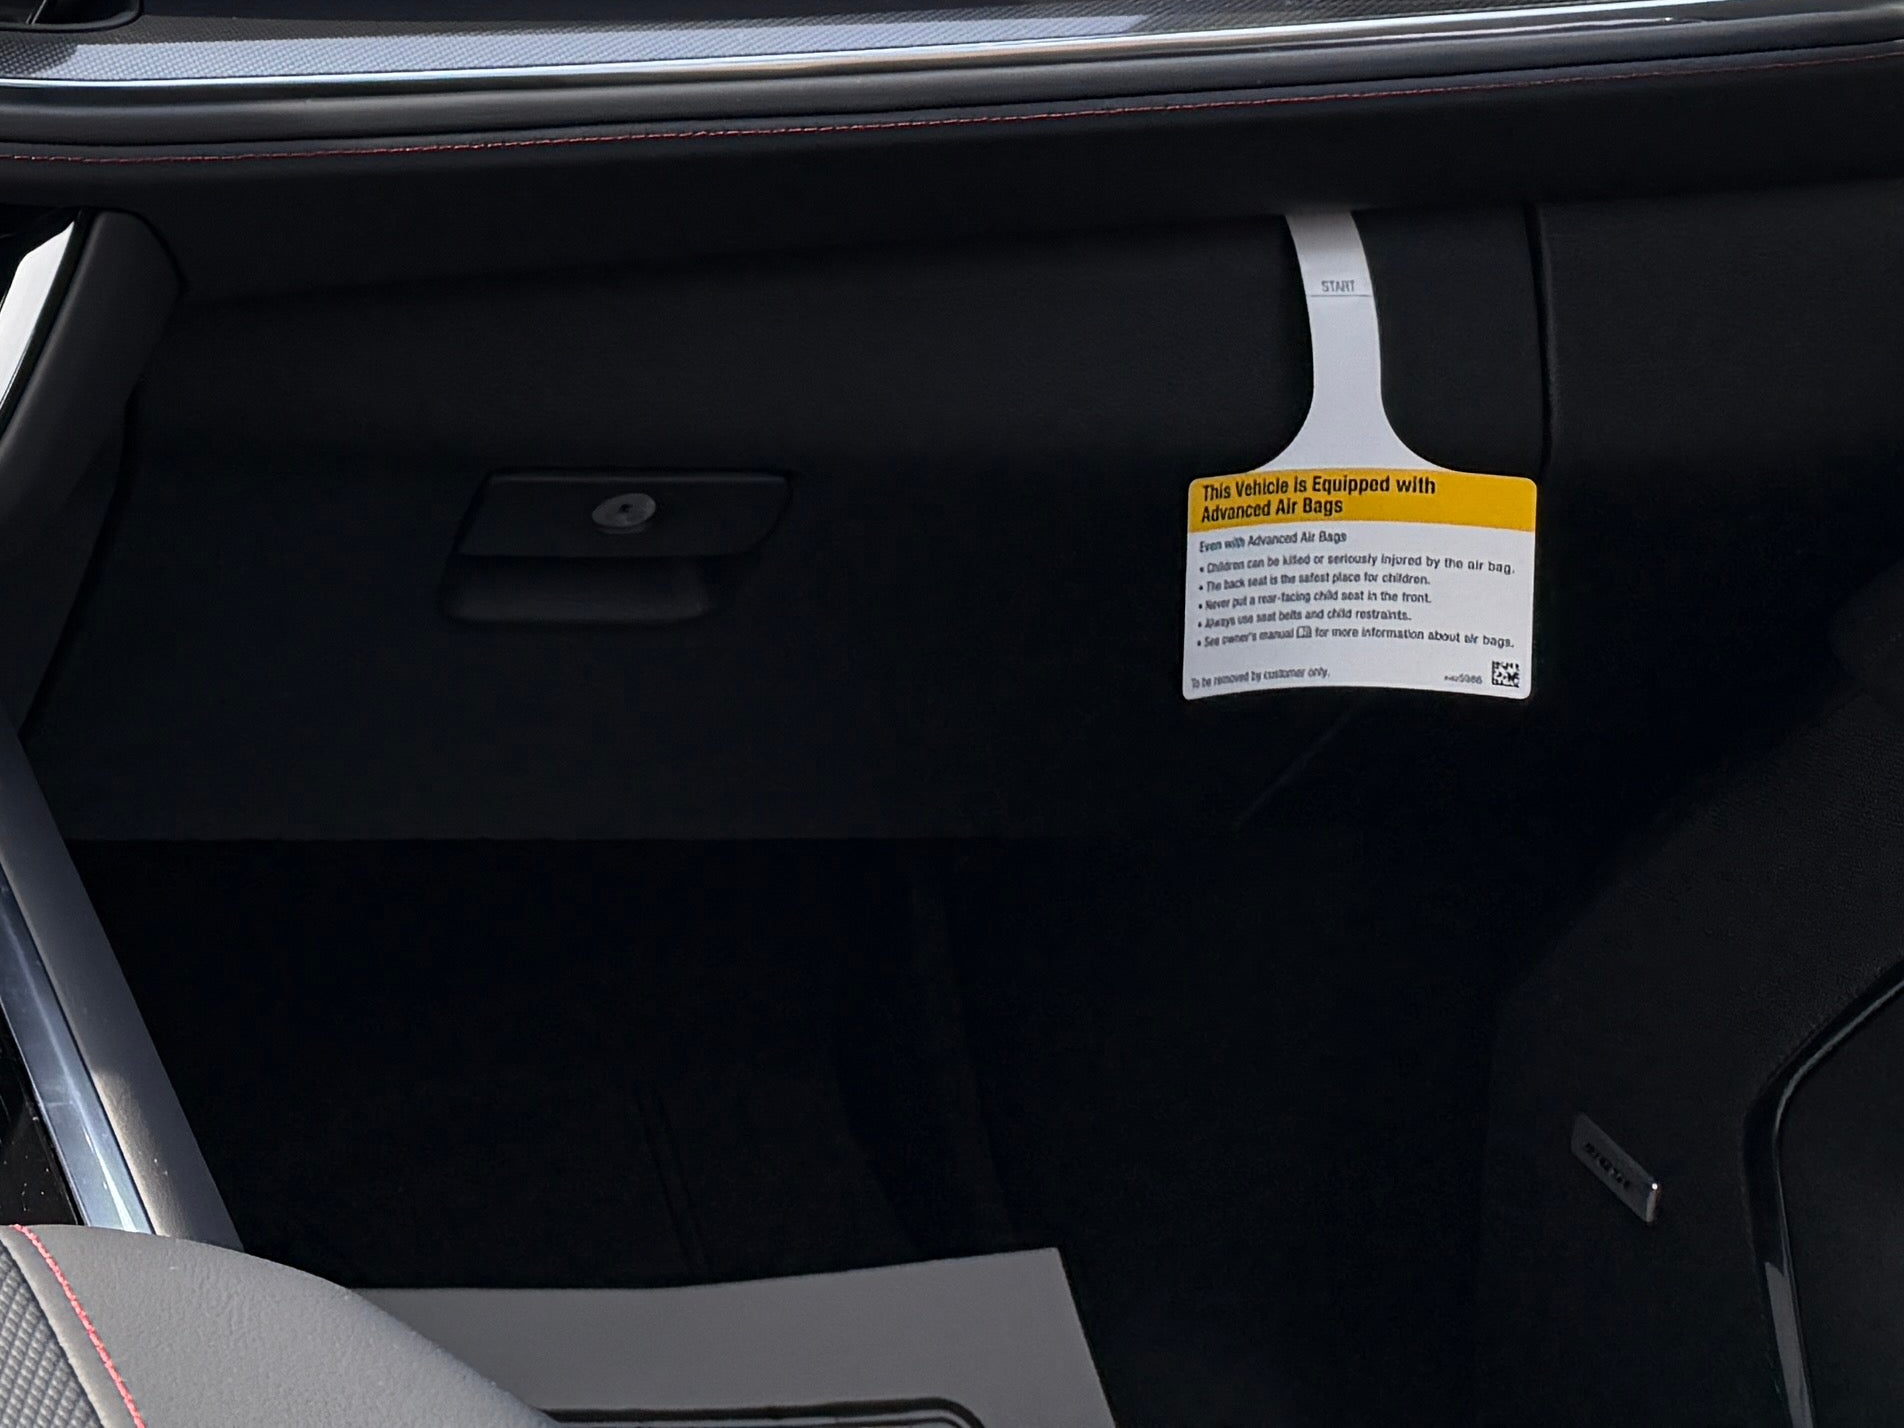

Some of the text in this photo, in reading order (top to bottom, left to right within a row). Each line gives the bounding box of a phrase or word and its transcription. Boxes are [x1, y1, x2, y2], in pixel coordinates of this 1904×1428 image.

[1320, 279, 1355, 293] START
[1202, 474, 1436, 502] This Vehicle is Equipped with
[1201, 497, 1344, 524] Advanced Air Bags
[1198, 530, 1348, 553] Even with Advanced Air Bags
[1206, 552, 1516, 576] Children can be killed or seriously injured by the air bag.
[1206, 571, 1431, 594] The back seat is the safest place for children.
[1204, 589, 1432, 611] Never put a rear-facing child seat in the front.
[1204, 607, 1412, 630] Always use seat belts and child restraints.
[1203, 626, 1515, 650] See owner's manual for more information about air bags.
[1212, 671, 1250, 687] removed
[1250, 669, 1263, 683] by
[1262, 666, 1307, 682] customer
[1307, 665, 1331, 680] only.
